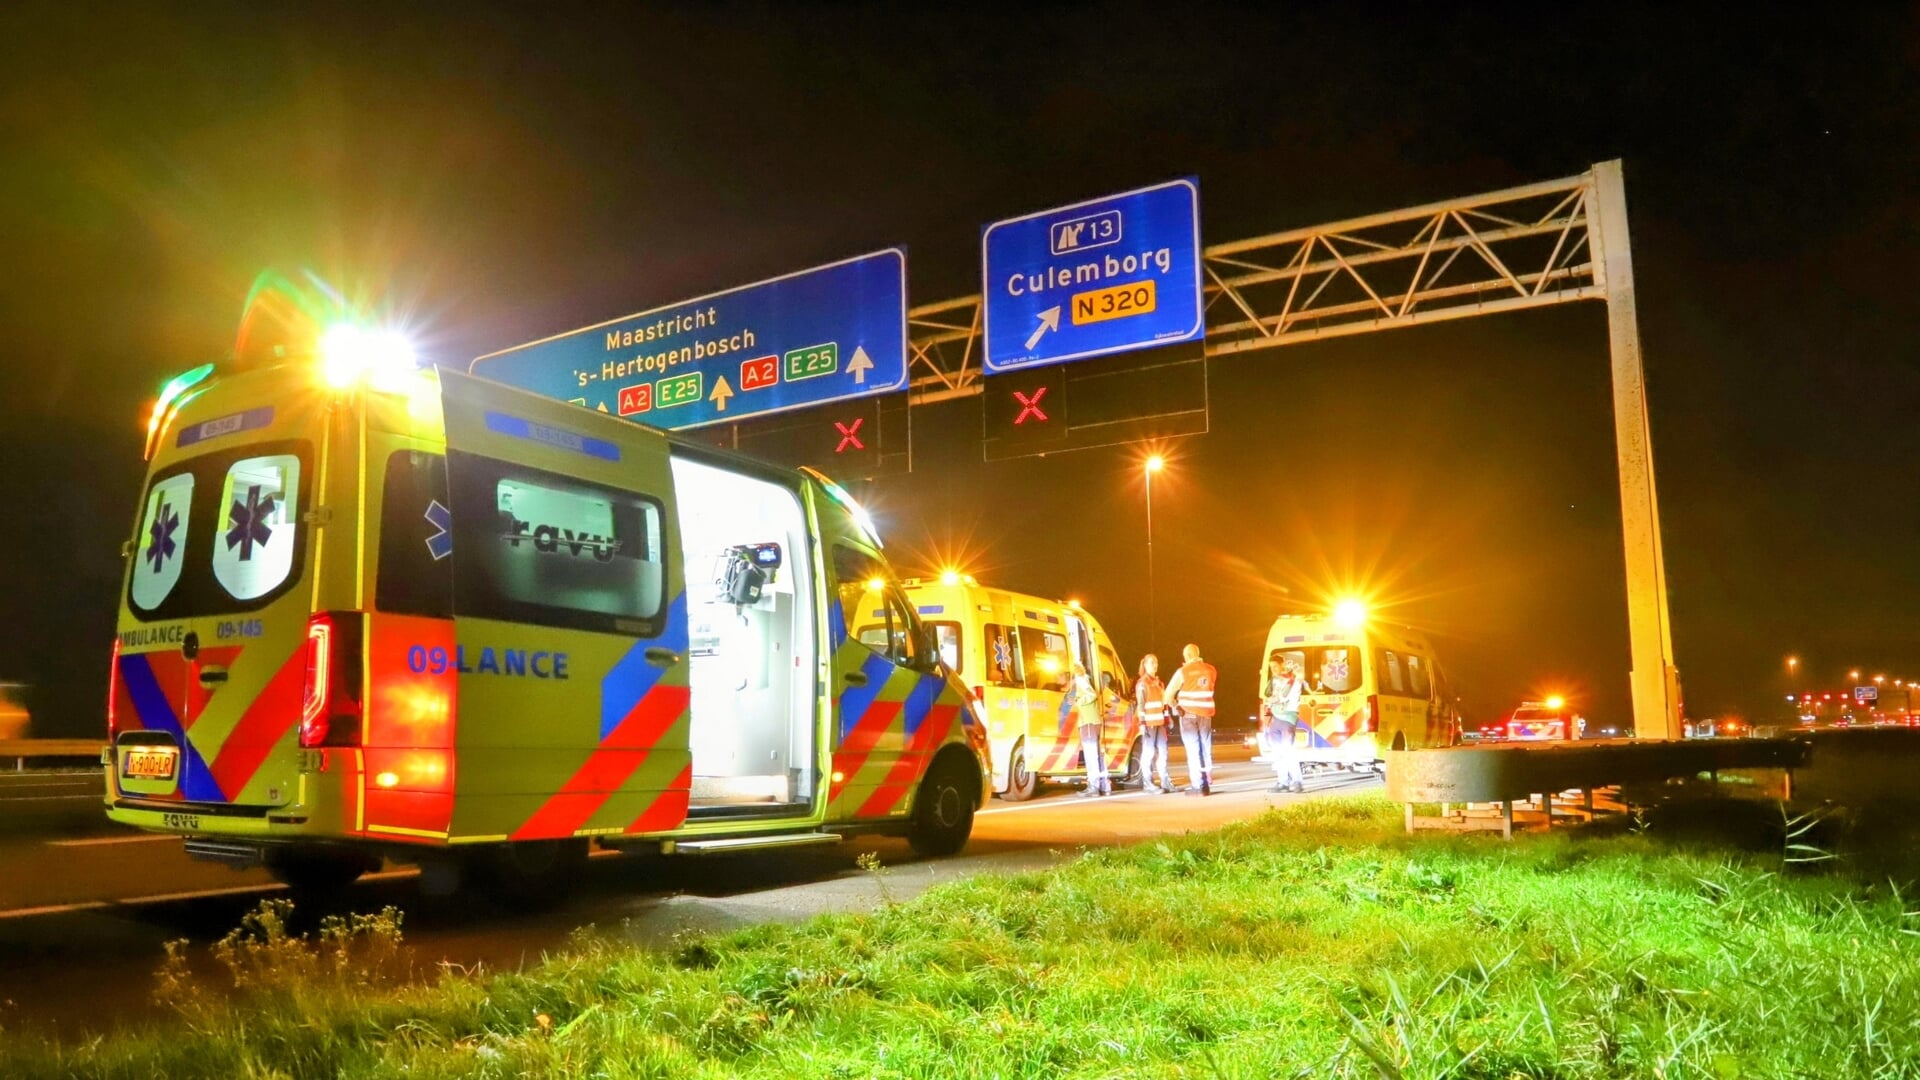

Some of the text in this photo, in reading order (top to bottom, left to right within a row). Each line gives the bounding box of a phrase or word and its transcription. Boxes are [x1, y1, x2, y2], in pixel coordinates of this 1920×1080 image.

[1090, 219, 1113, 240] 13
[1007, 247, 1170, 297] Culemborg
[606, 307, 717, 351] Maastricht
[573, 329, 756, 387] 's-Hertogenbosch
[511, 520, 615, 563] ravu
[216, 620, 264, 639] 09-145
